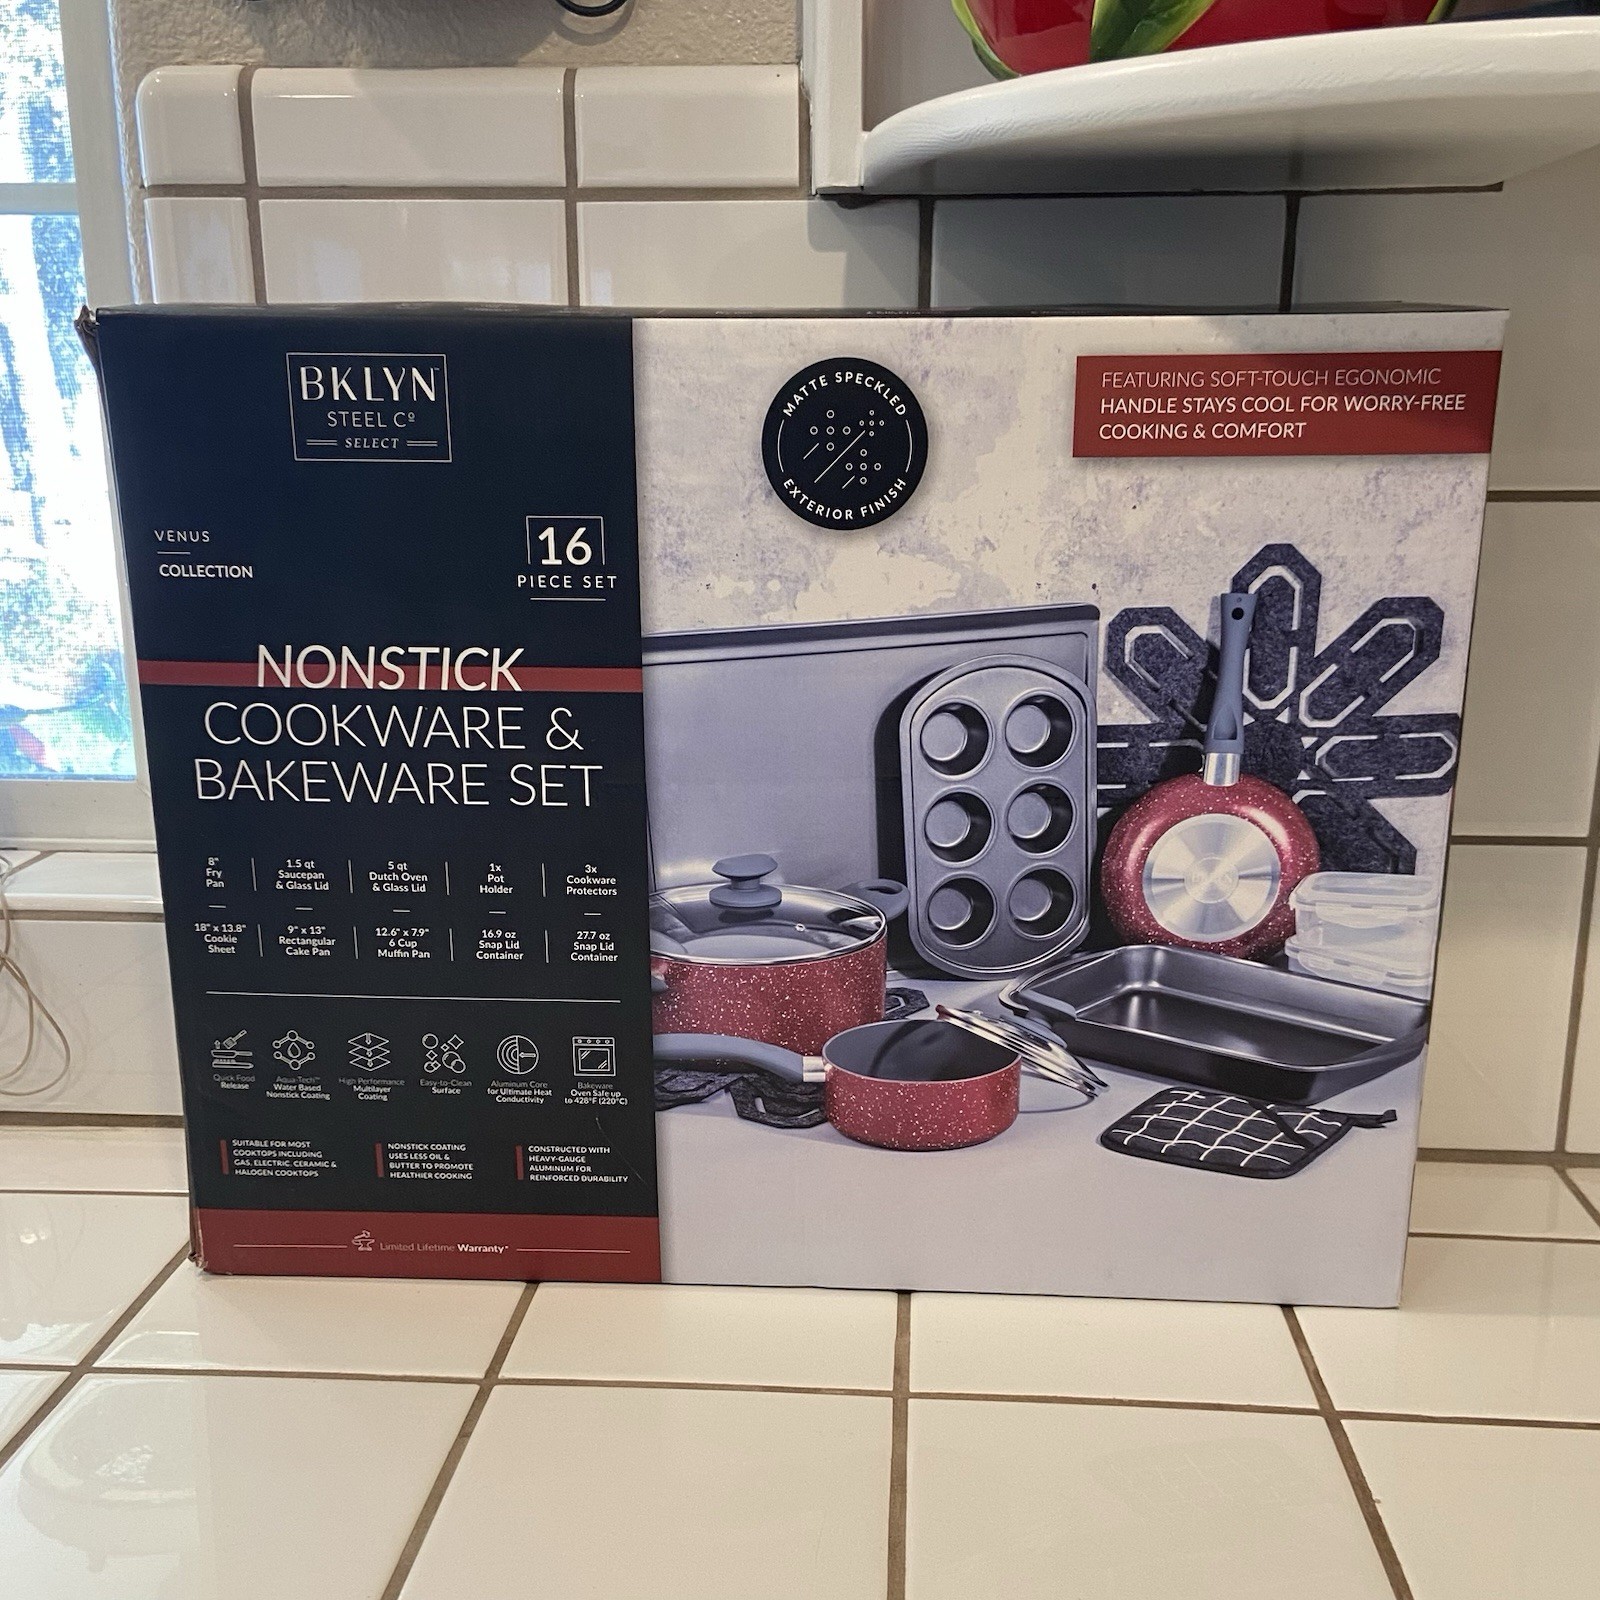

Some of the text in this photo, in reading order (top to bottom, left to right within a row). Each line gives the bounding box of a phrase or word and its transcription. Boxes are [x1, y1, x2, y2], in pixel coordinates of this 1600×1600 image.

[1102, 368, 1441, 388] FEATURING SOFT-TOUCH EGONOMIC
[783, 372, 906, 416] MATTE SPECKLED
[1101, 394, 1466, 414] HANDLE STAYS COOL FOR WORRY-FREE
[327, 411, 387, 428] STEEL
[1100, 422, 1306, 440] COOKING & COMFORT
[345, 438, 400, 449] SELECT
[784, 478, 906, 520] EXTERIOR FINISH
[154, 530, 210, 543] VENUS
[538, 527, 592, 566] 16
[159, 564, 254, 579] COLLECTION
[517, 574, 617, 589] PIECE SET
[257, 644, 524, 691] NONSTICK
[204, 701, 584, 750] COOKWARE &
[194, 758, 603, 807] BAKEWARE SET
[286, 859, 315, 870] 1.5 qt
[388, 862, 408, 872] 5 qt
[489, 863, 501, 872] 1x
[585, 865, 597, 873] 3x
[206, 868, 222, 879] Fry
[278, 870, 325, 881] Saucepan
[369, 872, 428, 882] Dutch Oven
[488, 874, 504, 883] Pot
[566, 876, 616, 884] Cookware
[206, 879, 224, 888] Pan
[275, 880, 329, 891] & Glass Lid
[372, 883, 426, 893] & Glass Lid
[480, 885, 513, 894] Holder
[566, 886, 617, 896] Protectors
[204, 934, 238, 944] Cookie
[482, 930, 503, 939] 16.9
[576, 931, 597, 940] 27.7
[278, 936, 336, 946] Rectangular
[388, 939, 417, 949] 6 Cup
[479, 940, 520, 950] Snap Lid
[208, 945, 236, 954] Sheet
[573, 942, 615, 952] Snap Lid
[286, 947, 331, 957] Cake Pan
[378, 949, 430, 959] Muffin Pan
[476, 951, 524, 960] Container
[570, 953, 618, 962] Container
[213, 1074, 256, 1083] Quick Food
[358, 1078, 405, 1086] Performance
[221, 1082, 250, 1090] Release
[273, 1083, 322, 1092] Water Based
[420, 1079, 472, 1088] Easy-to-Clean
[491, 1080, 528, 1088] Aluminum
[577, 1082, 613, 1090] Bakeware
[353, 1085, 391, 1093] Multilayer
[499, 1088, 533, 1096] Ultimate
[266, 1091, 330, 1100] Nonstick Coating
[358, 1092, 388, 1101] Coating
[570, 1089, 621, 1099] Oven Safe up
[496, 1096, 544, 1104] Conductivity
[232, 1139, 269, 1147] SUITABLE
[270, 1140, 286, 1148] FOR
[388, 1143, 466, 1151] NONSTICK COATING
[233, 1149, 323, 1159] COOKTOPS INCLUDING
[528, 1145, 610, 1154] CONSTRUCTED WITH
[529, 1155, 586, 1163] HEAVY-GAUGE
[293, 1160, 329, 1168] CERAMIC
[421, 1162, 433, 1170] TO
[435, 1162, 474, 1170] PROMOTE
[529, 1164, 592, 1173] ALUMINUM FOR
[275, 1169, 319, 1177] COOKTOPS
[390, 1171, 473, 1180] HEALTHIER COOKING
[530, 1174, 629, 1183] REINFORCED DURABILITY
[380, 1242, 415, 1251] Limited
[417, 1243, 455, 1252] Lifetime
